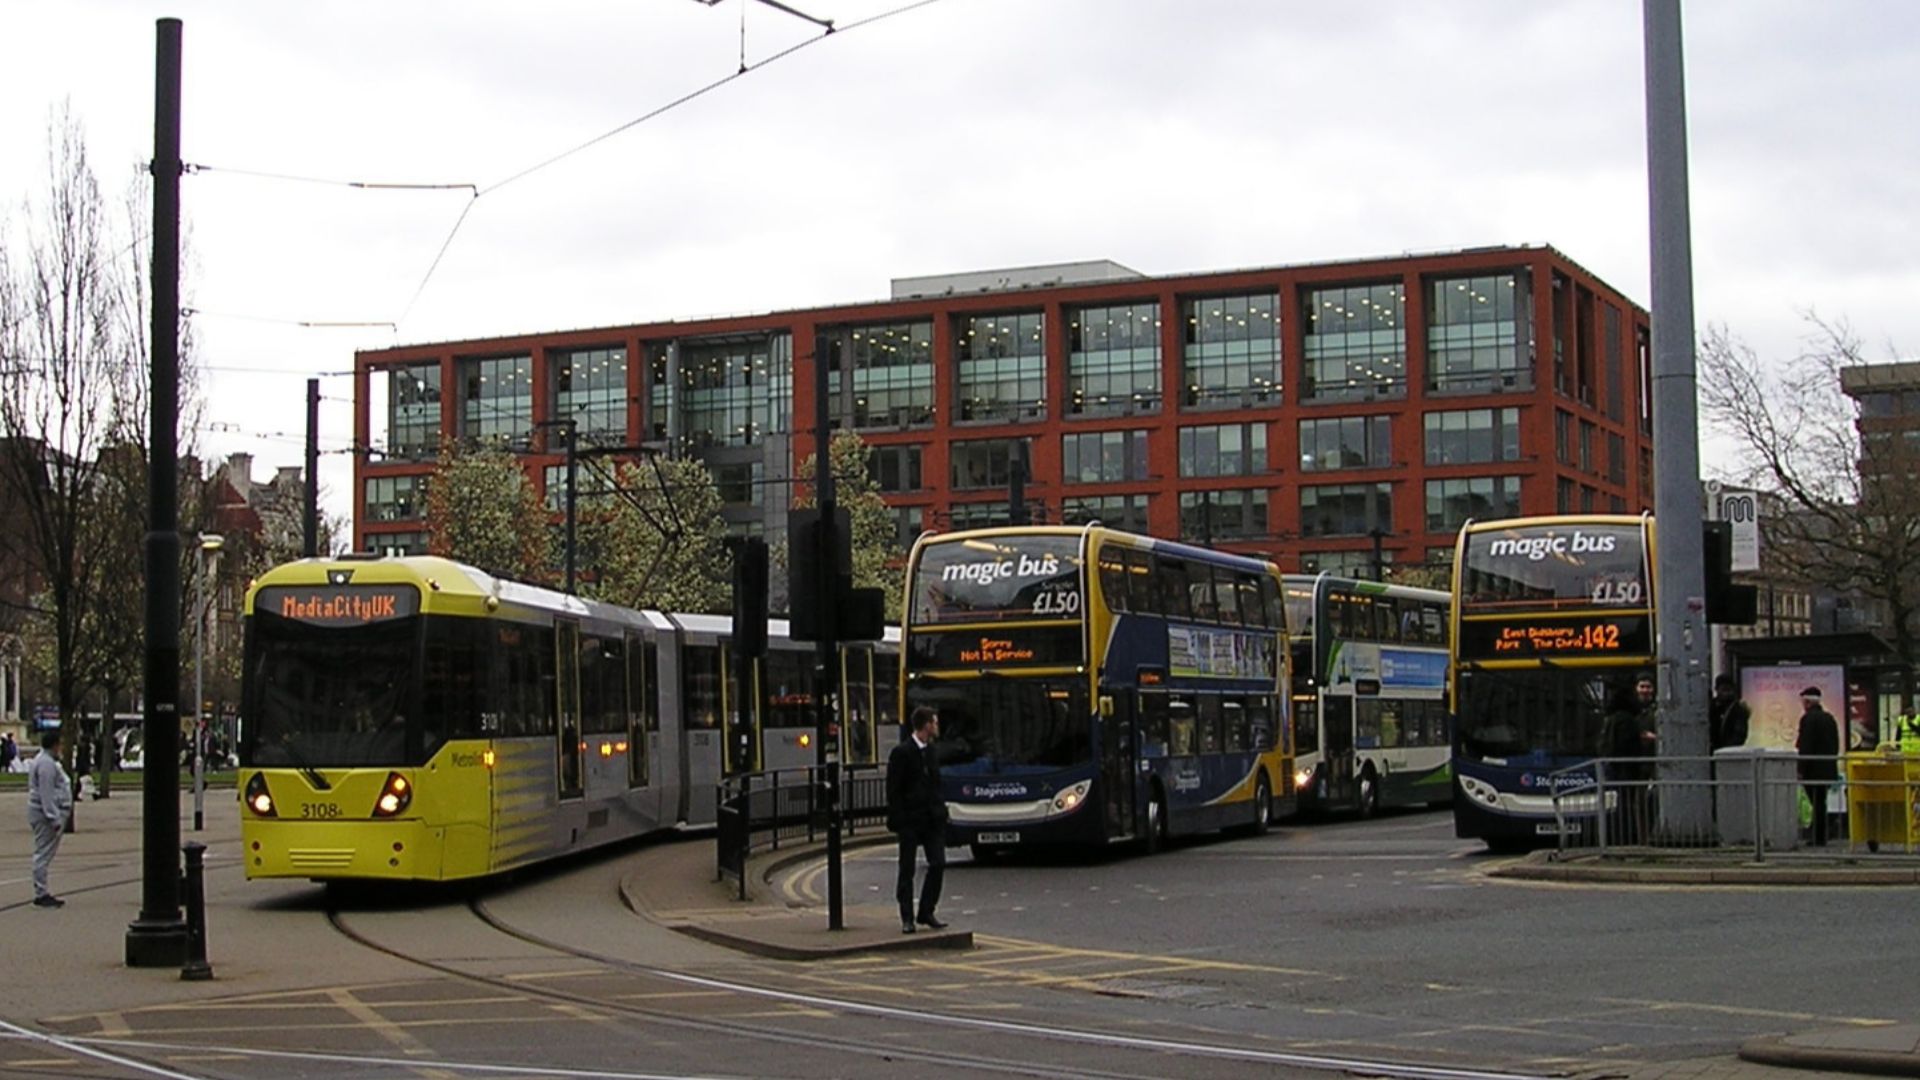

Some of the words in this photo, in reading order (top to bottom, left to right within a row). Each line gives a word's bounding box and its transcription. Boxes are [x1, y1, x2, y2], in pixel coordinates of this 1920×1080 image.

[1490, 533, 1566, 560] magic
[1571, 531, 1615, 552] bus
[942, 556, 1013, 585] magic
[1017, 554, 1059, 576] bus
[1032, 591, 1079, 614] £1.50
[1592, 582, 1641, 603] £1.50
[283, 595, 396, 620] MediaCityUK
[981, 638, 1012, 650] Sorry
[1583, 625, 1619, 648] 142
[960, 651, 980, 662] Not
[982, 650, 994, 661] In
[995, 649, 1033, 661] Service
[974, 785, 1028, 799] Stagecoach
